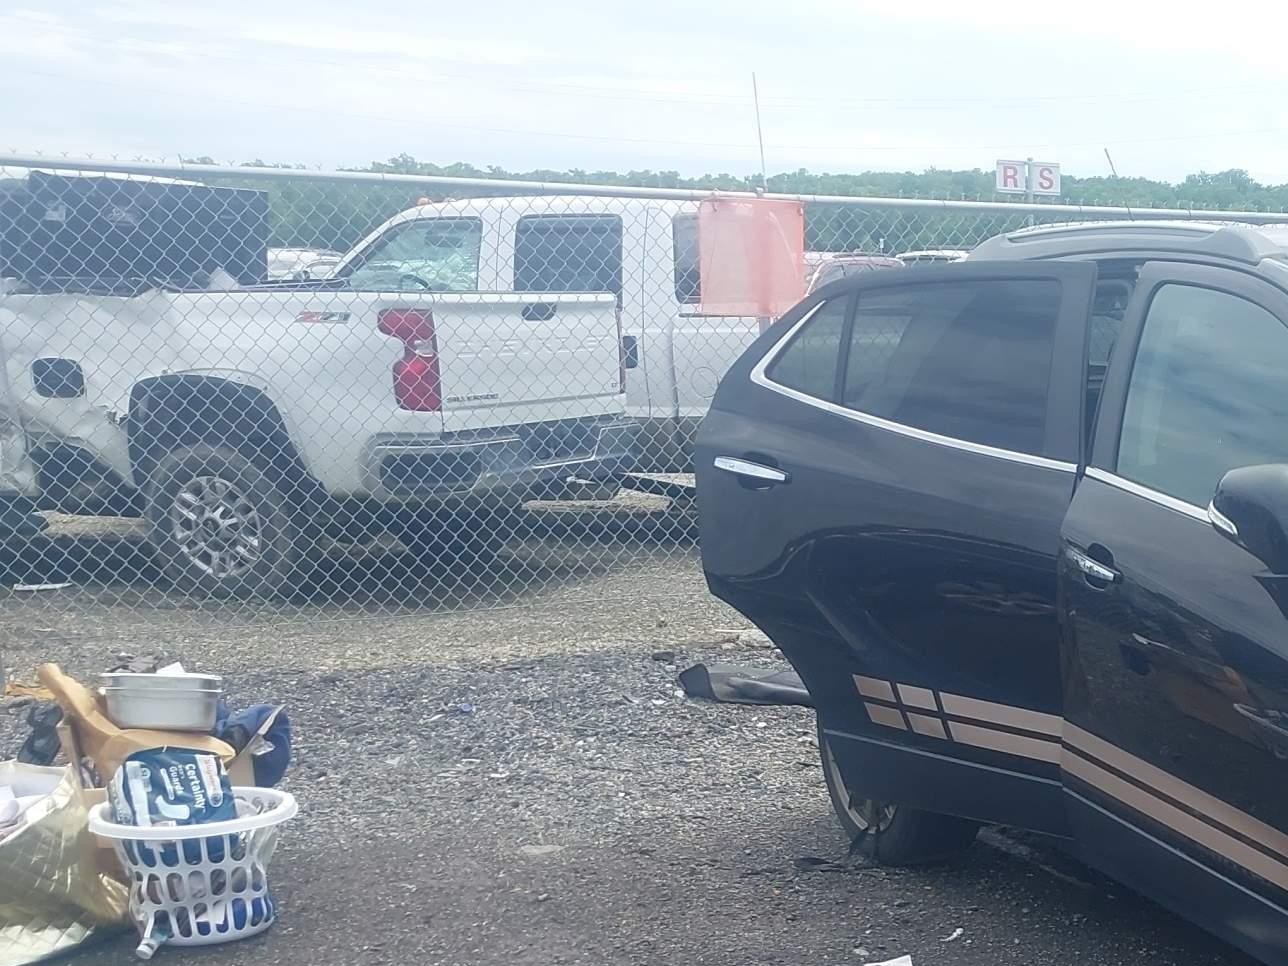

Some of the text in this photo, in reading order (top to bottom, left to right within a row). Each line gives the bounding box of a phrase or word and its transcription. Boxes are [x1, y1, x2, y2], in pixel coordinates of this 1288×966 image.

[1002, 165, 1018, 188] R
[1038, 167, 1054, 190] S
[185, 763, 206, 809] Certainty
